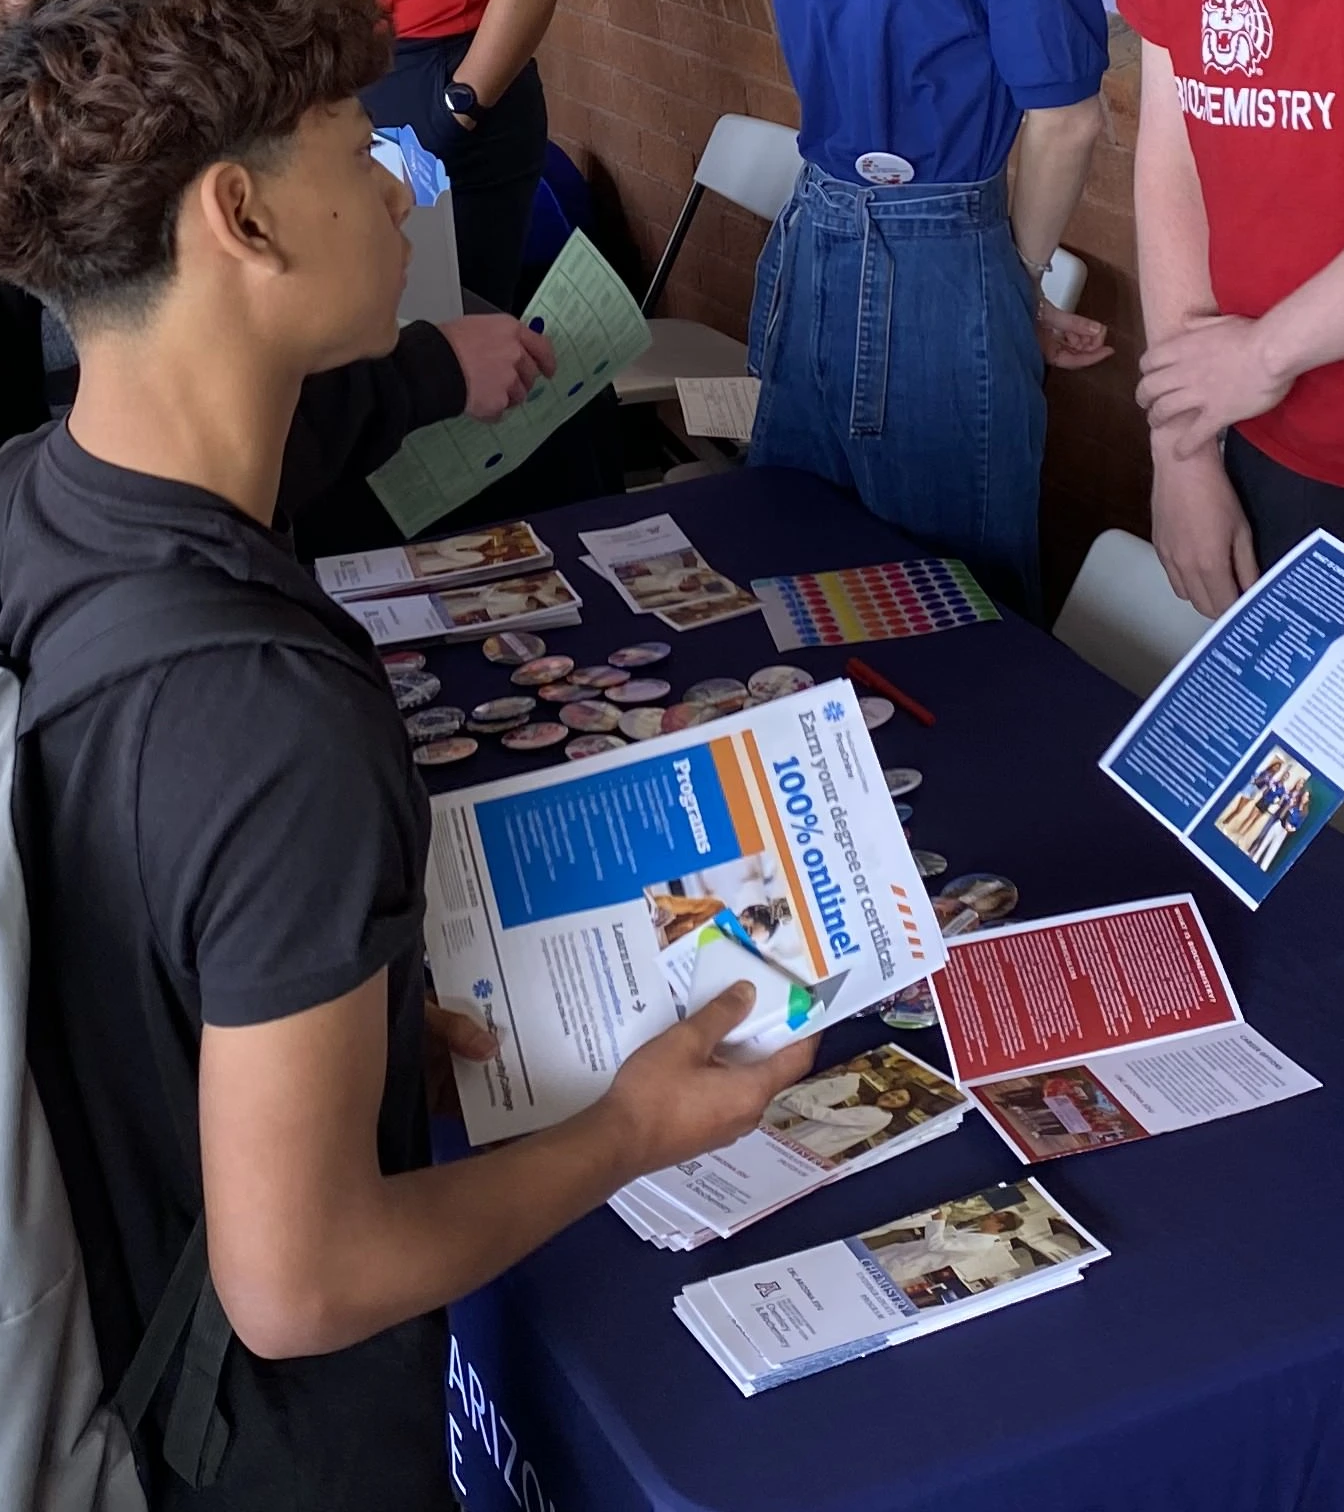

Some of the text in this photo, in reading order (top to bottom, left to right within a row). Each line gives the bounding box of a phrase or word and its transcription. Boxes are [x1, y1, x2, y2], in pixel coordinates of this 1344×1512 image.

[798, 710, 827, 757] Earn
[672, 757, 712, 856] Programs
[811, 758, 842, 805] your
[772, 755, 825, 847] 100%
[801, 844, 861, 959] online!
[828, 805, 864, 873] degree
[852, 874, 870, 895] or
[612, 922, 630, 961] Learn
[859, 896, 901, 980] certificate
[448, 1334, 555, 1512] ARIZO
